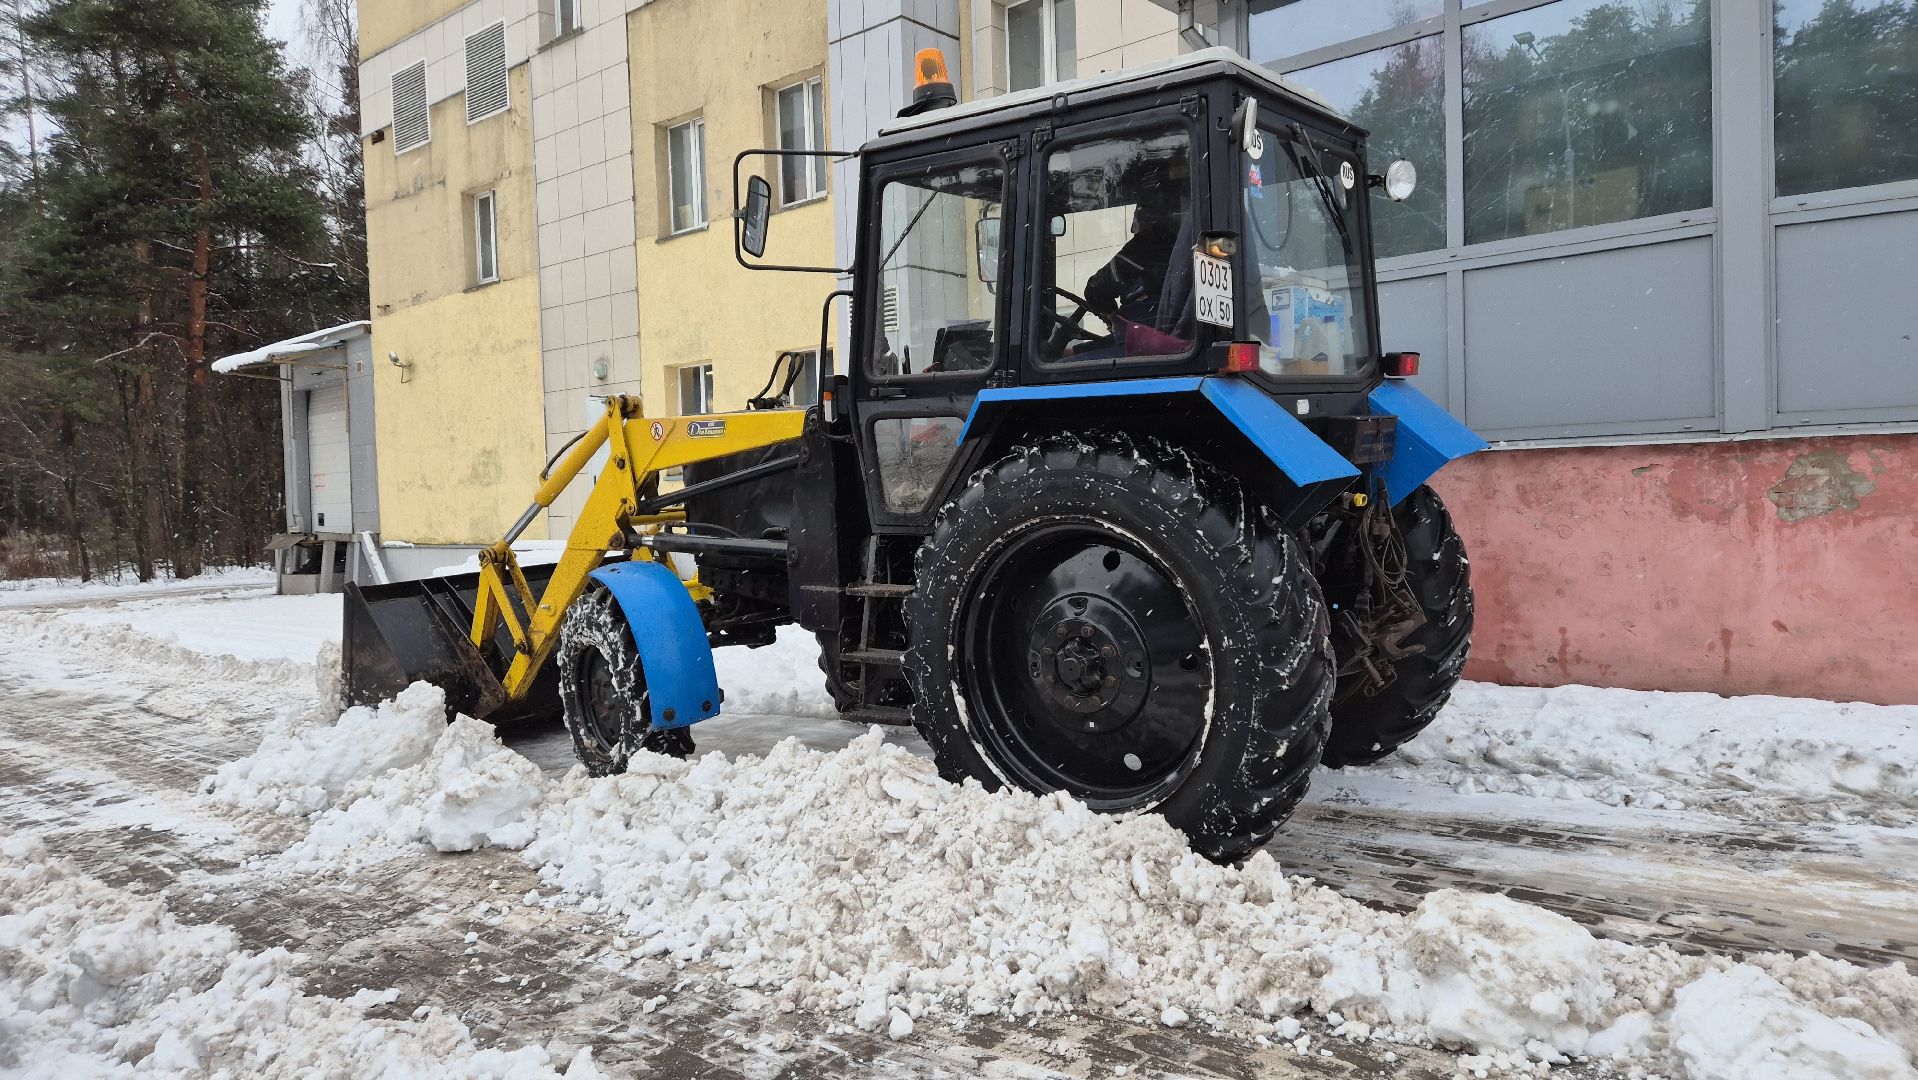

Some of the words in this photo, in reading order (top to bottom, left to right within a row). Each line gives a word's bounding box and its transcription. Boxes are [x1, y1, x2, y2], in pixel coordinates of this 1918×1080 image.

[1252, 134, 1262, 150] US
[1200, 259, 1228, 291] 0303
[1219, 301, 1231, 322] 50
